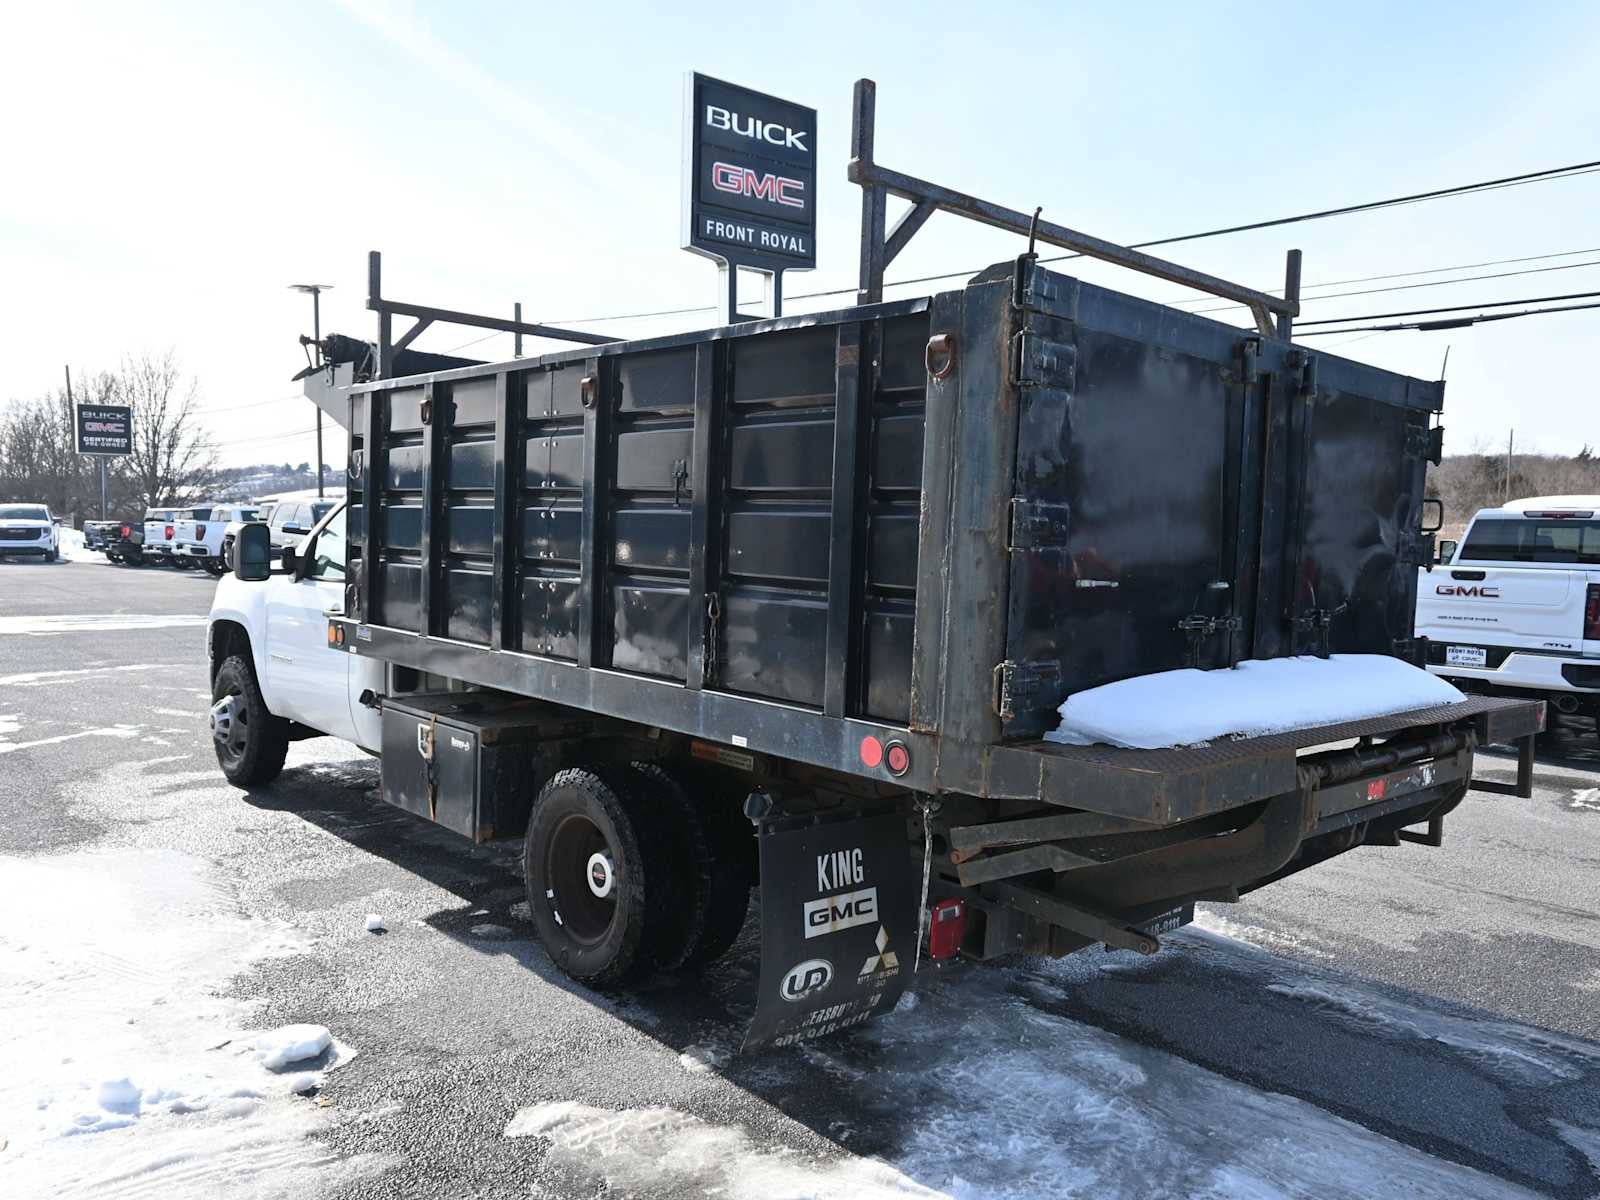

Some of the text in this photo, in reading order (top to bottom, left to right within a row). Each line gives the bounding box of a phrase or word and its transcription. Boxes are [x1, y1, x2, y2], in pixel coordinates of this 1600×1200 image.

[706, 105, 808, 152] BUICK
[712, 161, 804, 208] GMC
[706, 220, 806, 253] FRONT ROYAL
[82, 411, 127, 420] BUICK
[84, 421, 125, 433] GMC
[1435, 584, 1500, 598] GMC
[817, 847, 864, 892] KING
[809, 897, 873, 927] GMC
